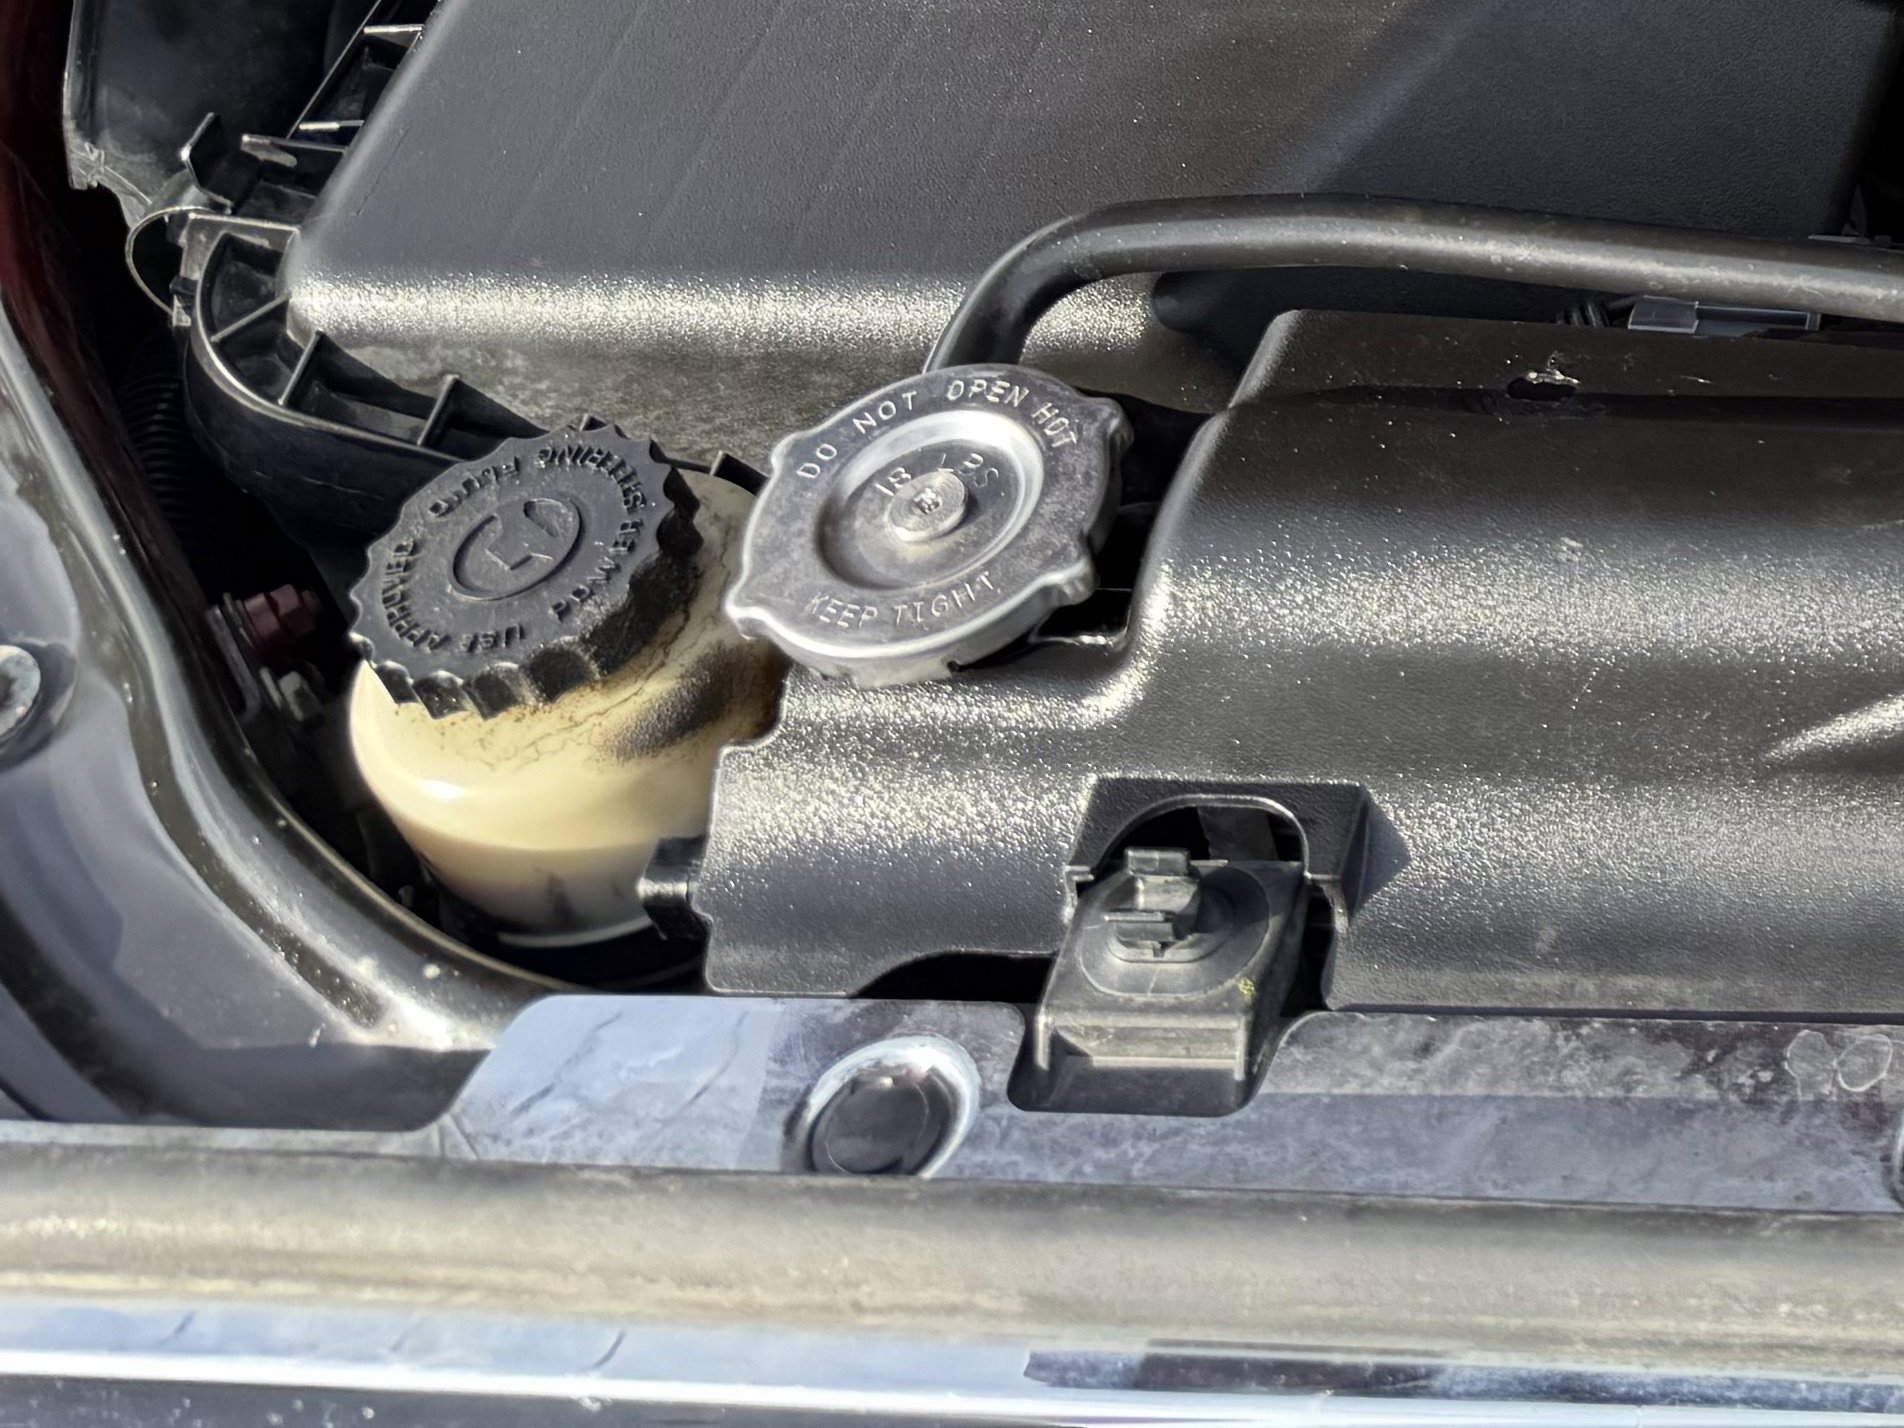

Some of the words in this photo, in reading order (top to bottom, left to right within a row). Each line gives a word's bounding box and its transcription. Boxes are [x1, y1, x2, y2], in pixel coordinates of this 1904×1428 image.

[796, 443, 838, 480] DO
[852, 391, 918, 434] NOT
[945, 379, 1029, 408] OPEN
[1031, 402, 1079, 449] HOT
[804, 592, 879, 629] KEEP
[894, 570, 997, 627] TIGHT
